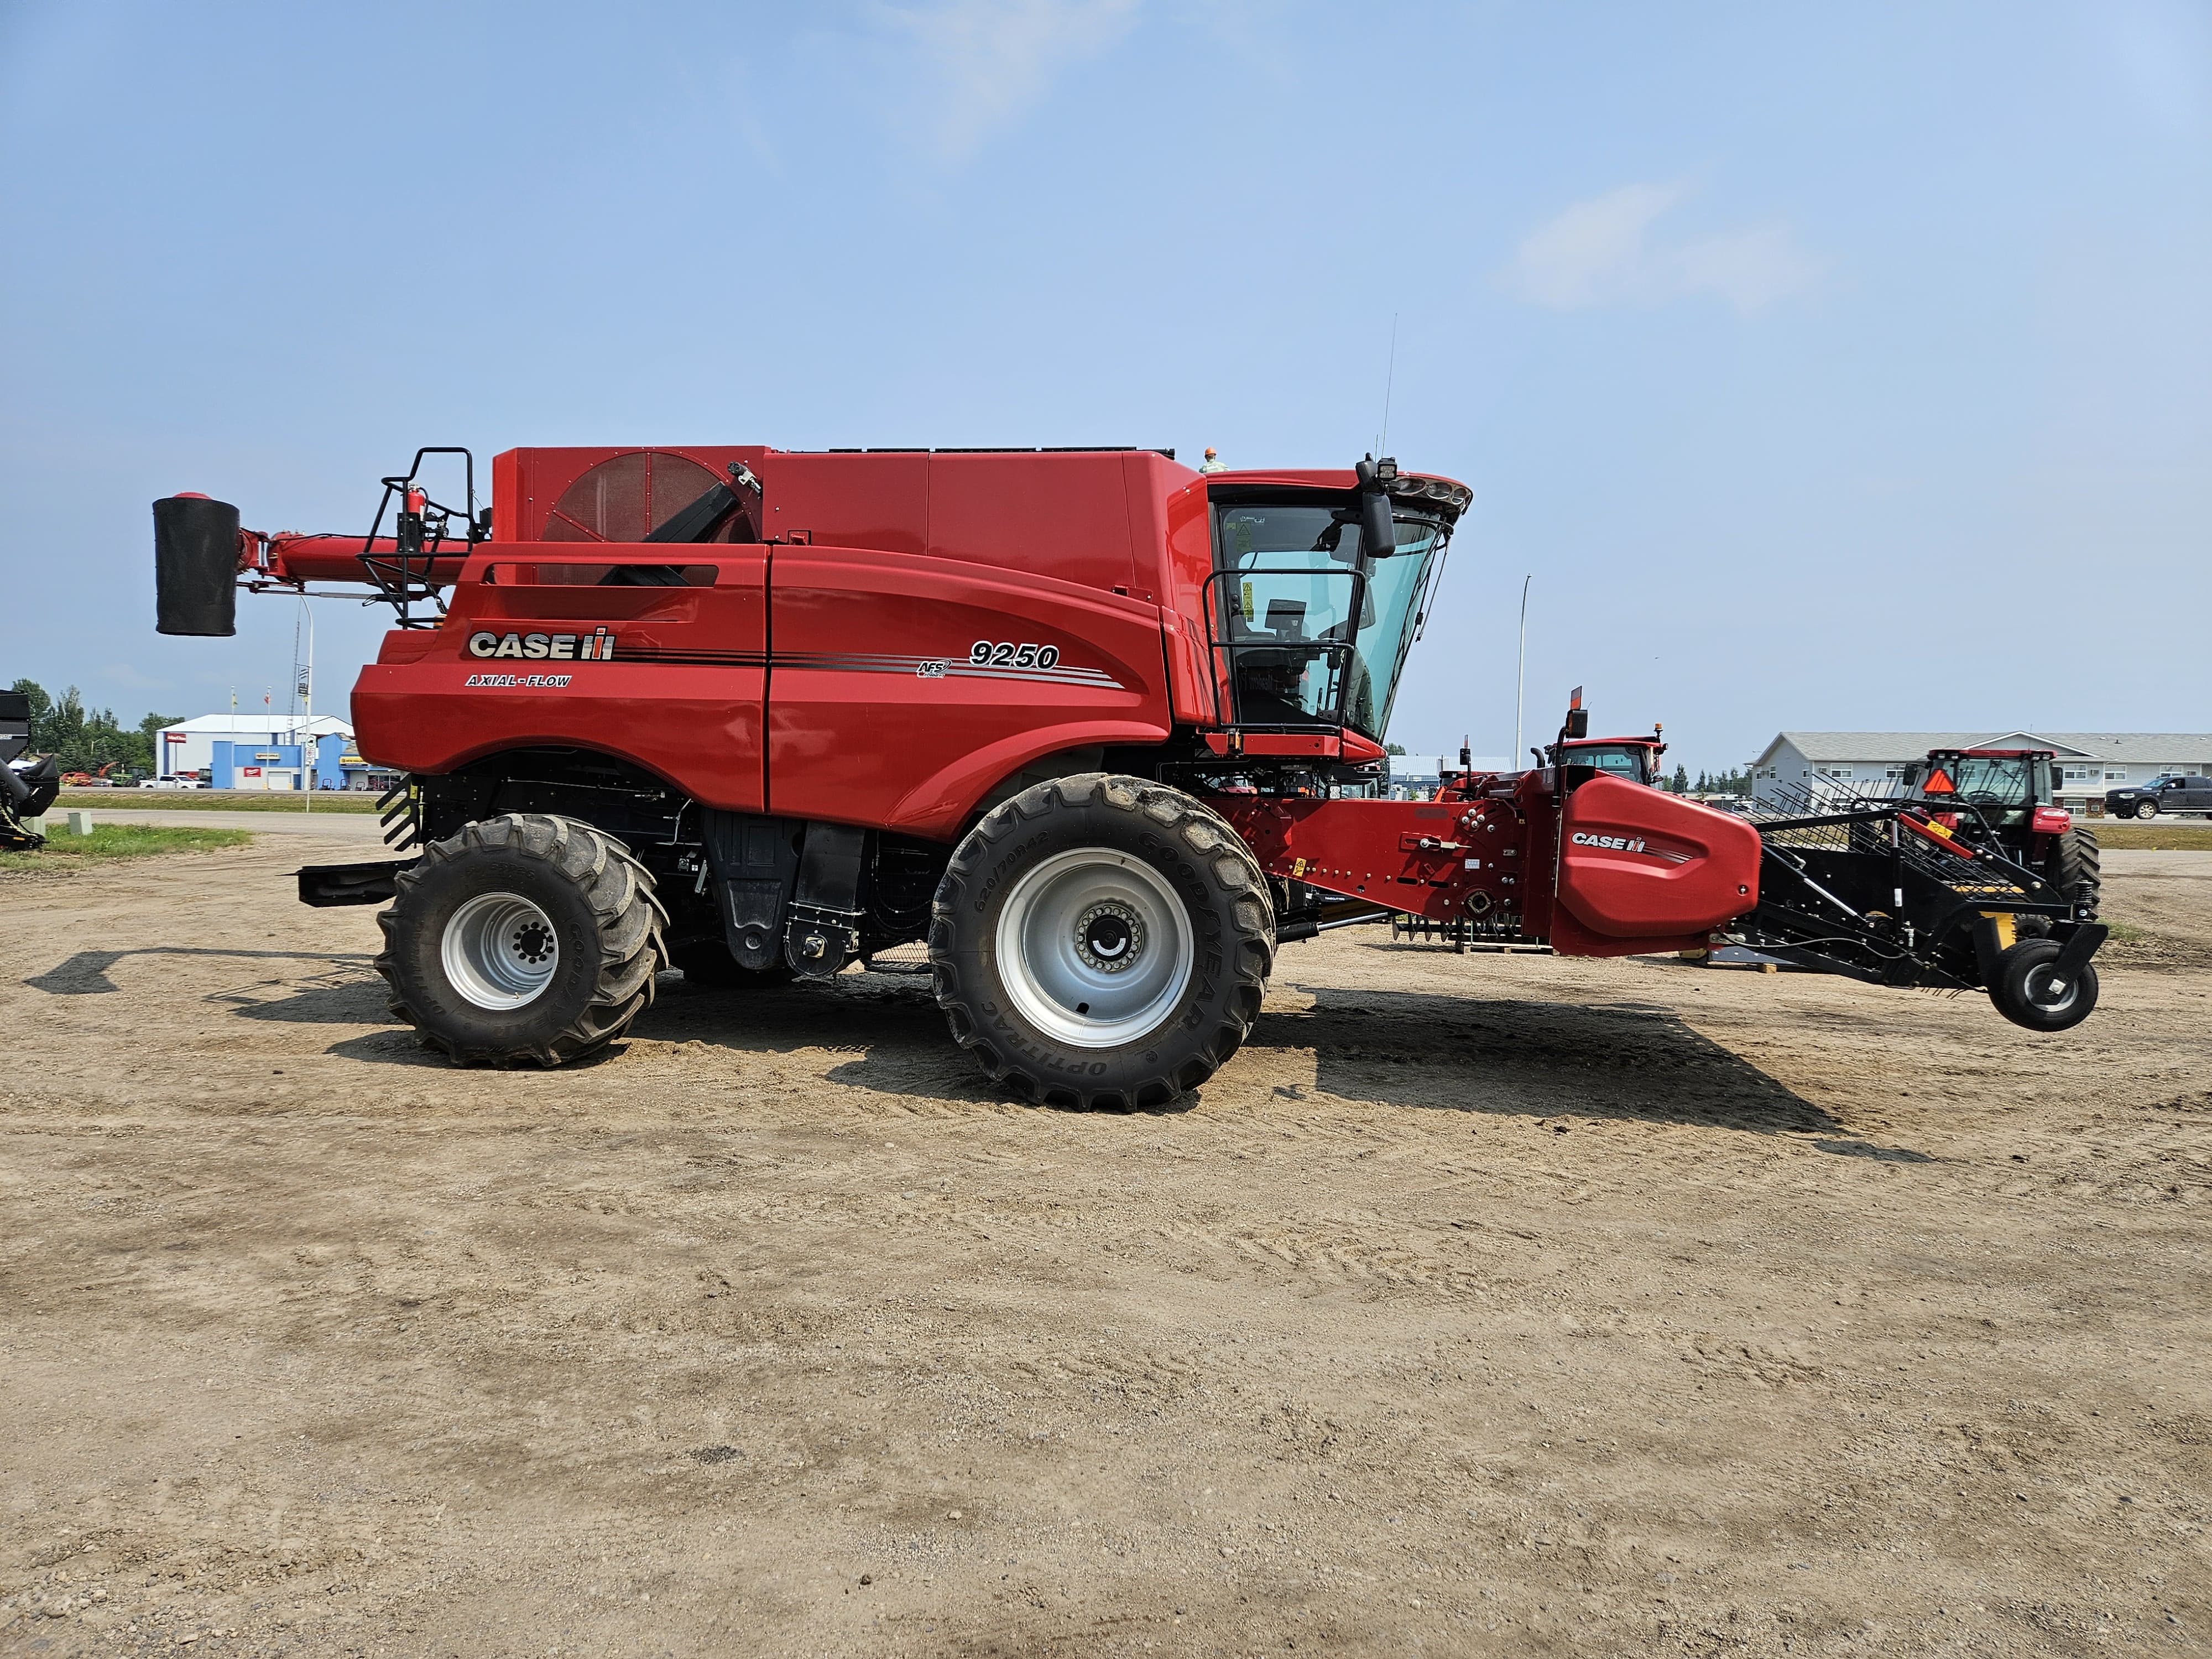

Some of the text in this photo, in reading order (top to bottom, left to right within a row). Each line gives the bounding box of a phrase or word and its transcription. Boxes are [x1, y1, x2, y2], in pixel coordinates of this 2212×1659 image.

[469, 632, 576, 659] CASE
[969, 640, 1060, 671] 9250
[465, 675, 572, 687] AXIAL-FLOW
[917, 661, 945, 672] AFS
[1572, 832, 1626, 849] CASE
[973, 830, 1050, 914] 620/70R42
[1138, 831, 1223, 1032] GOODYEAR
[980, 1001, 1107, 1076] OPTITRAC
